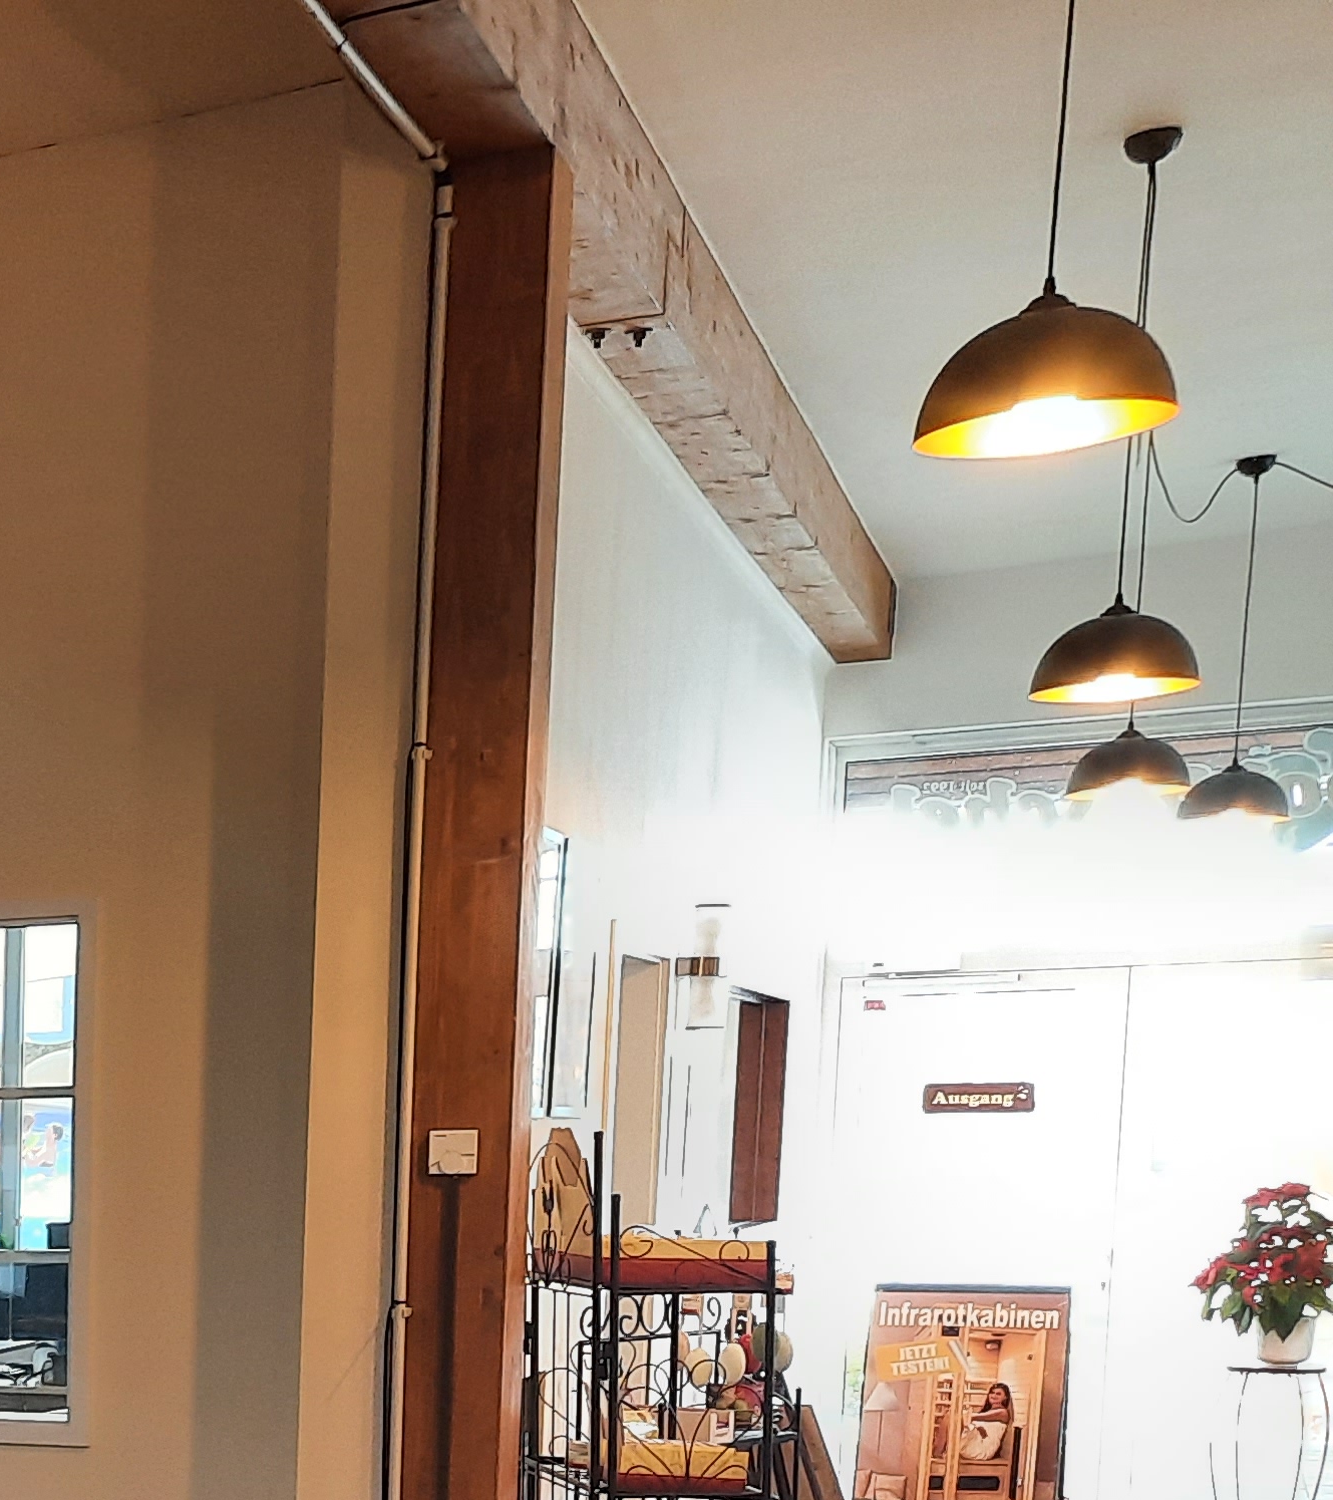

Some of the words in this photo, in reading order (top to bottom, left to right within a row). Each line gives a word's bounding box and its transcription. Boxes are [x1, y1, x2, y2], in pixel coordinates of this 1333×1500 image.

[932, 1091, 1015, 1108] Ausgang
[878, 1300, 1061, 1330] Infrarotkabinen
[899, 1343, 938, 1361] JETZT
[890, 1356, 950, 1376] TESTEN!
